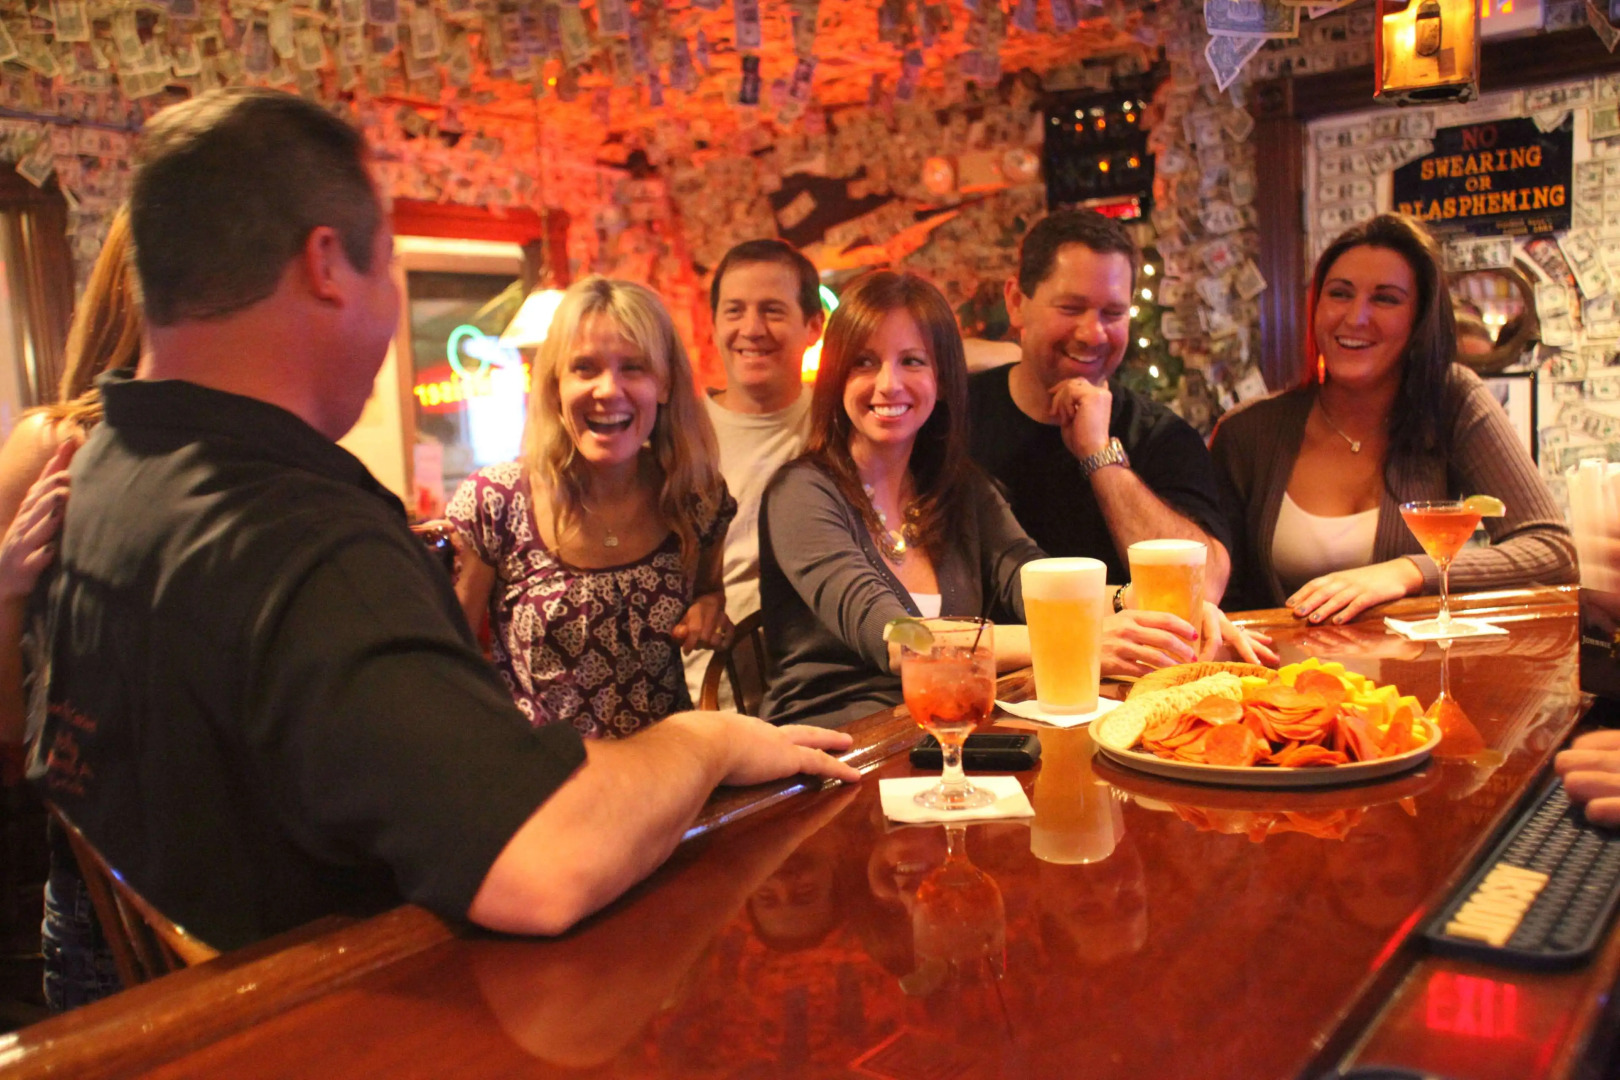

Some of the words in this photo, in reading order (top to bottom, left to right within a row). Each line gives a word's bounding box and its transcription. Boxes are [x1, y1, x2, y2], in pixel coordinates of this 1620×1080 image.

[1462, 125, 1497, 150] NO
[1421, 145, 1542, 180] SWEARING
[1465, 174, 1492, 192] OR
[1399, 184, 1566, 221] BLASPHEMING
